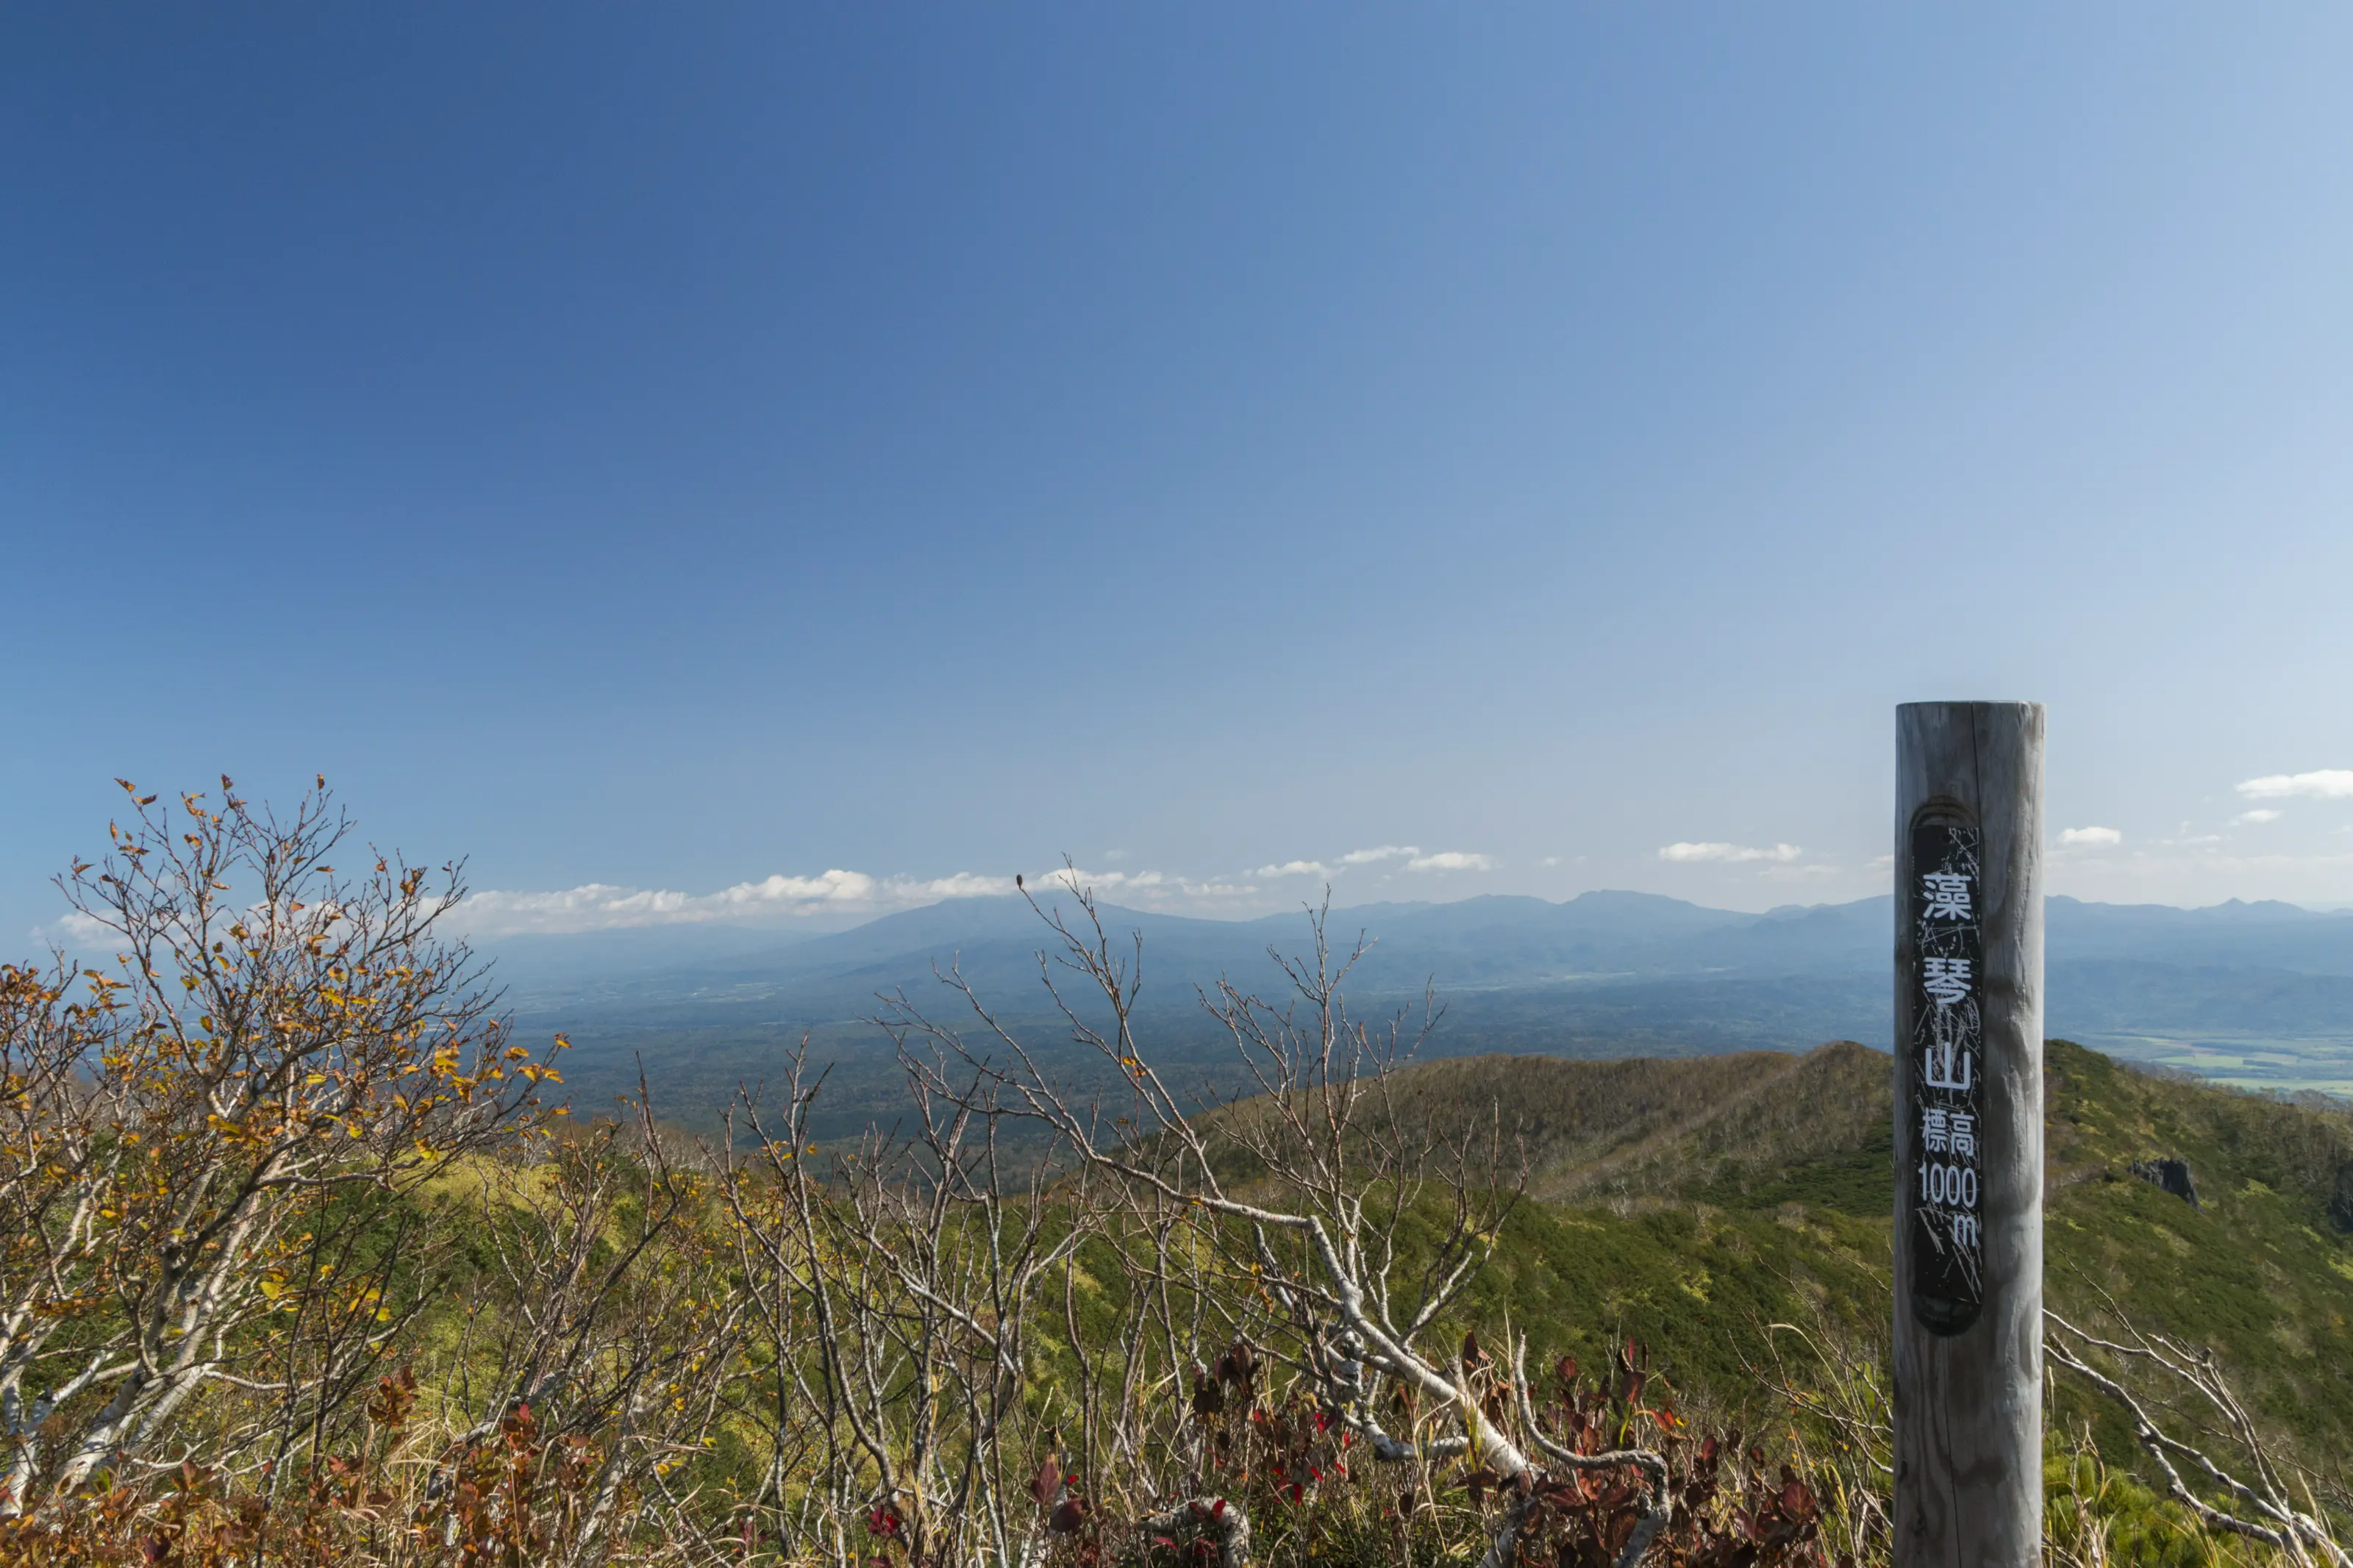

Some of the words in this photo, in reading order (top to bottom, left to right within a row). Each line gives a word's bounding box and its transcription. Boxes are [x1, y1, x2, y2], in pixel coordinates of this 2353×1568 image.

[1923, 873, 1971, 1089] 藻琴山
[1922, 1107, 1974, 1156] 標高
[1918, 1161, 1977, 1208] 1000
[1954, 1214, 1977, 1247] m
